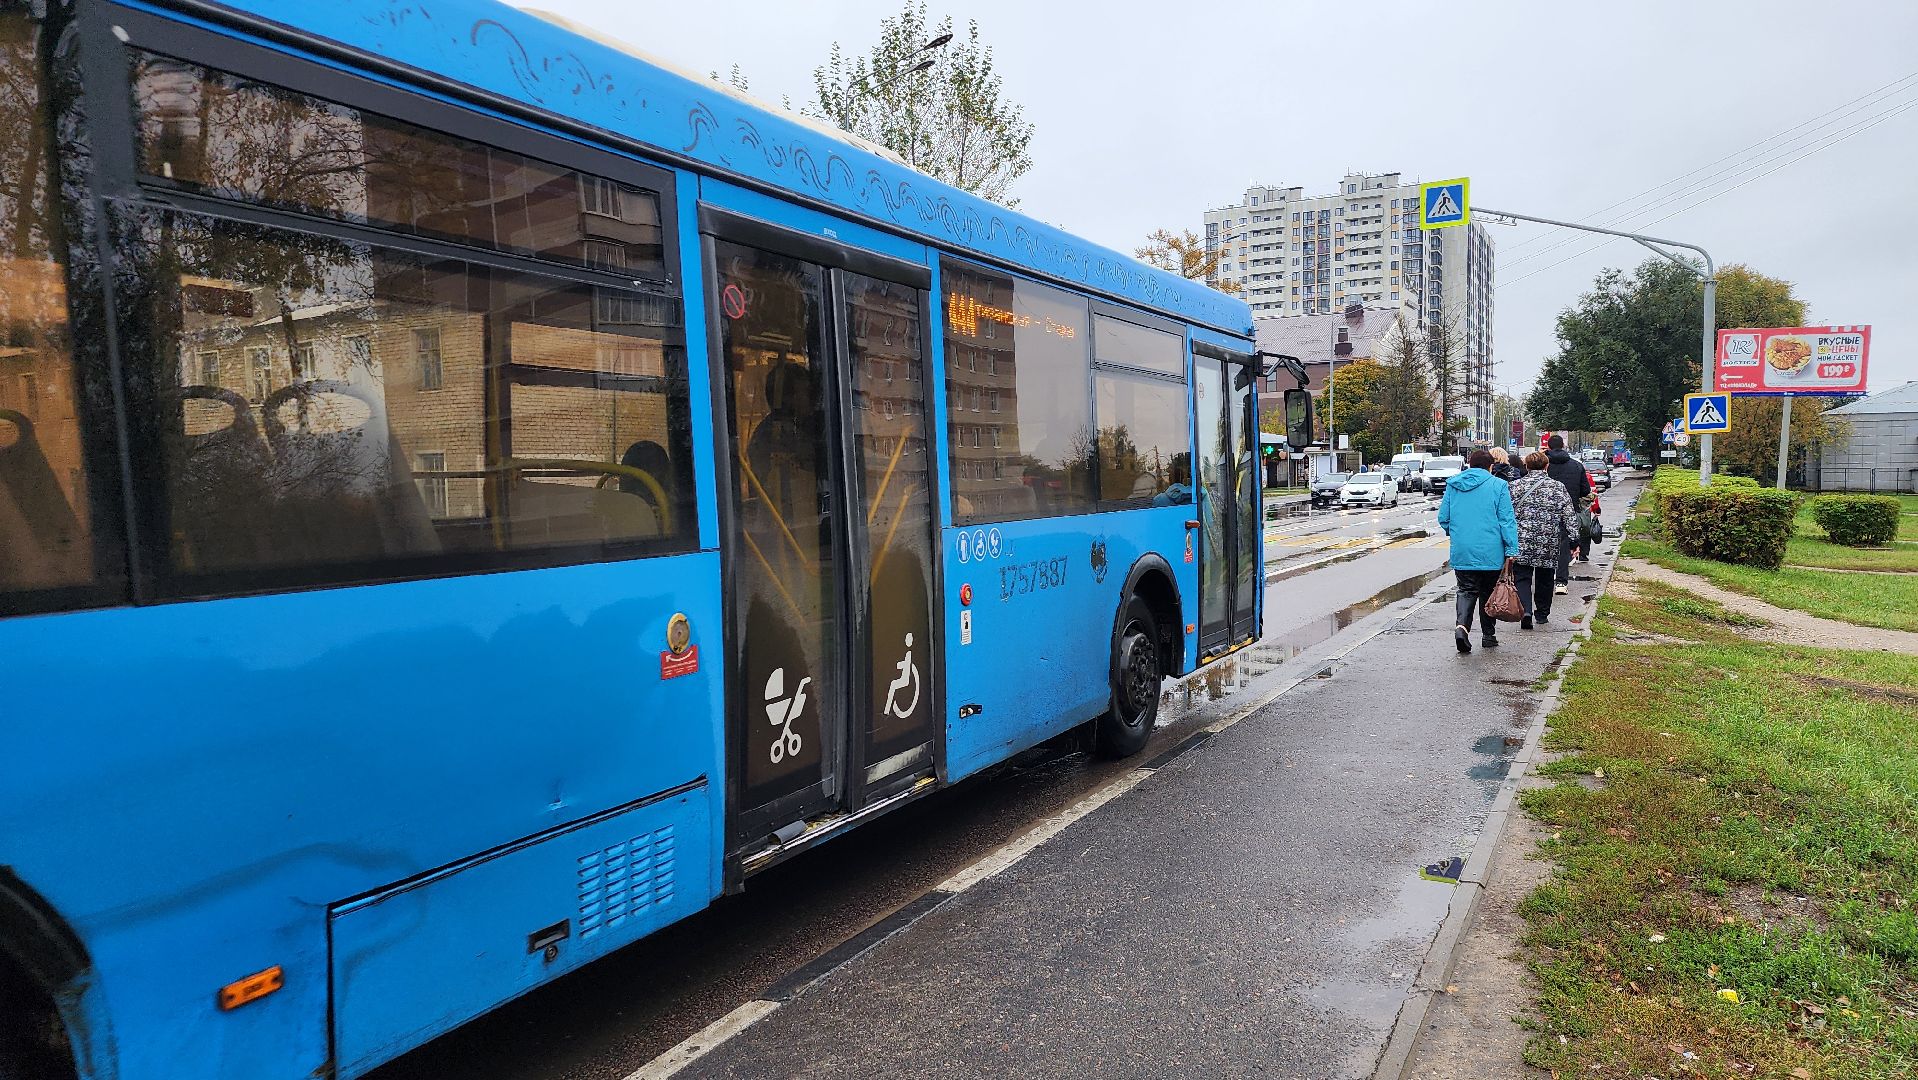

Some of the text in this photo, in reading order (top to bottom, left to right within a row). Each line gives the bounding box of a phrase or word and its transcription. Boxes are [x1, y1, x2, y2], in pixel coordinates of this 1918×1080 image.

[1818, 336, 1860, 346] ВКУСНЫЕ
[1831, 345, 1859, 354] ЦЕНЫ
[1817, 354, 1832, 362] МОЙ
